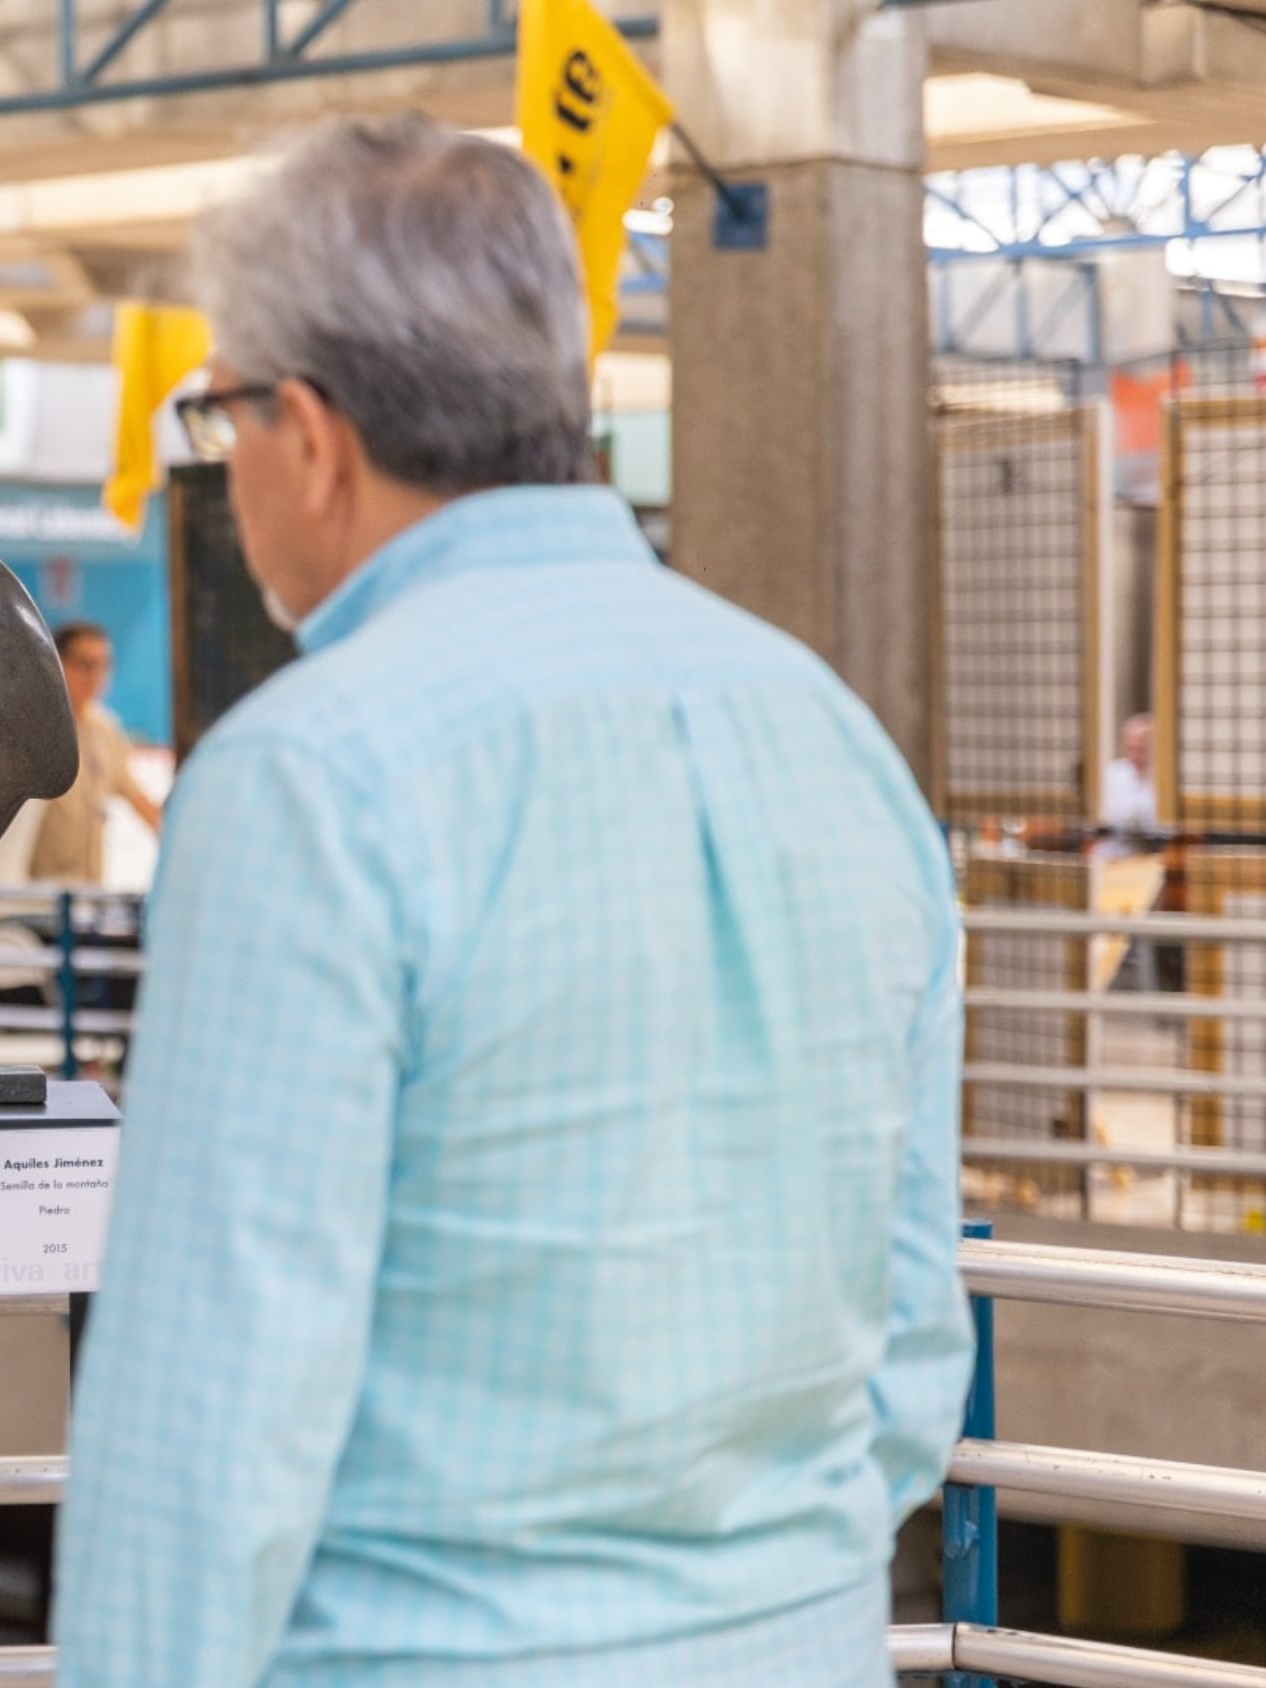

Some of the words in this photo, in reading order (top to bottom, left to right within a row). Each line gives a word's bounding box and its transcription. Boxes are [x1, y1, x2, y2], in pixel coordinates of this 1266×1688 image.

[3, 1157, 49, 1171] Aquiles
[53, 1156, 104, 1169] Jiménez
[37, 1179, 50, 1190] de
[53, 1179, 63, 1189] la
[38, 1204, 71, 1216] Piedra
[42, 1242, 68, 1254] 2015
